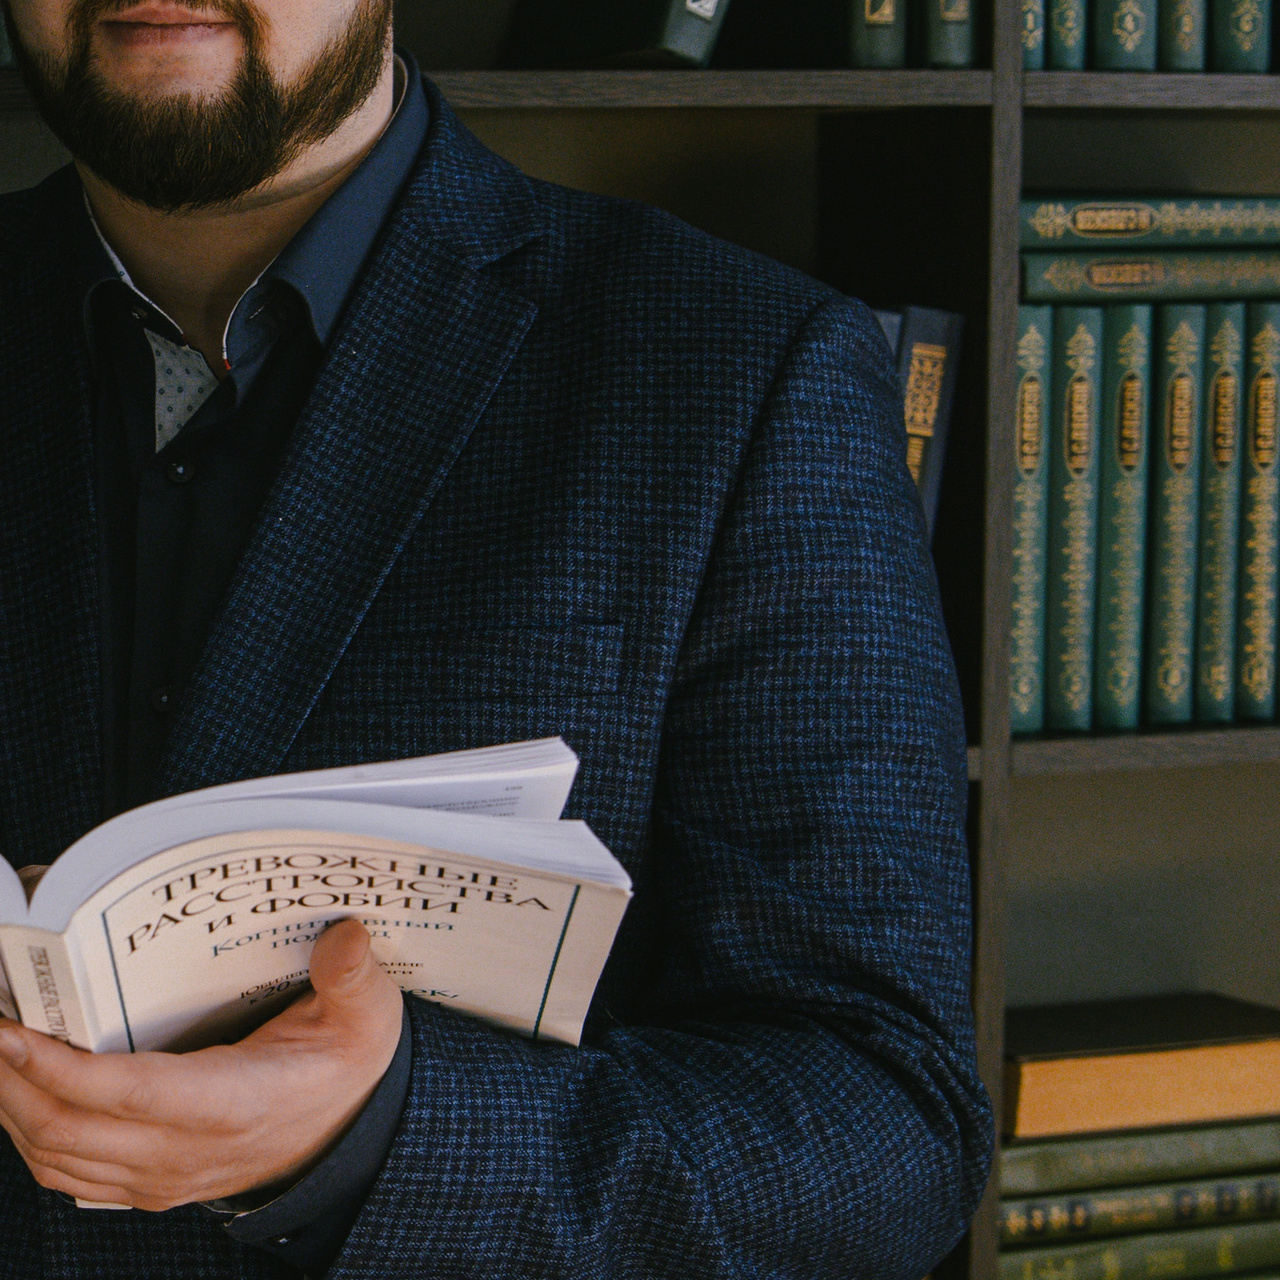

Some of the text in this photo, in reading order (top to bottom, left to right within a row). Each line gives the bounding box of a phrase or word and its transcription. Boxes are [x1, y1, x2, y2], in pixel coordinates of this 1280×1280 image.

[153, 853, 518, 902] ТРЕВОЖНЫЕ
[127, 873, 553, 955] РАССТРОЙСТВА
[251, 891, 461, 915] ФОБИИ
